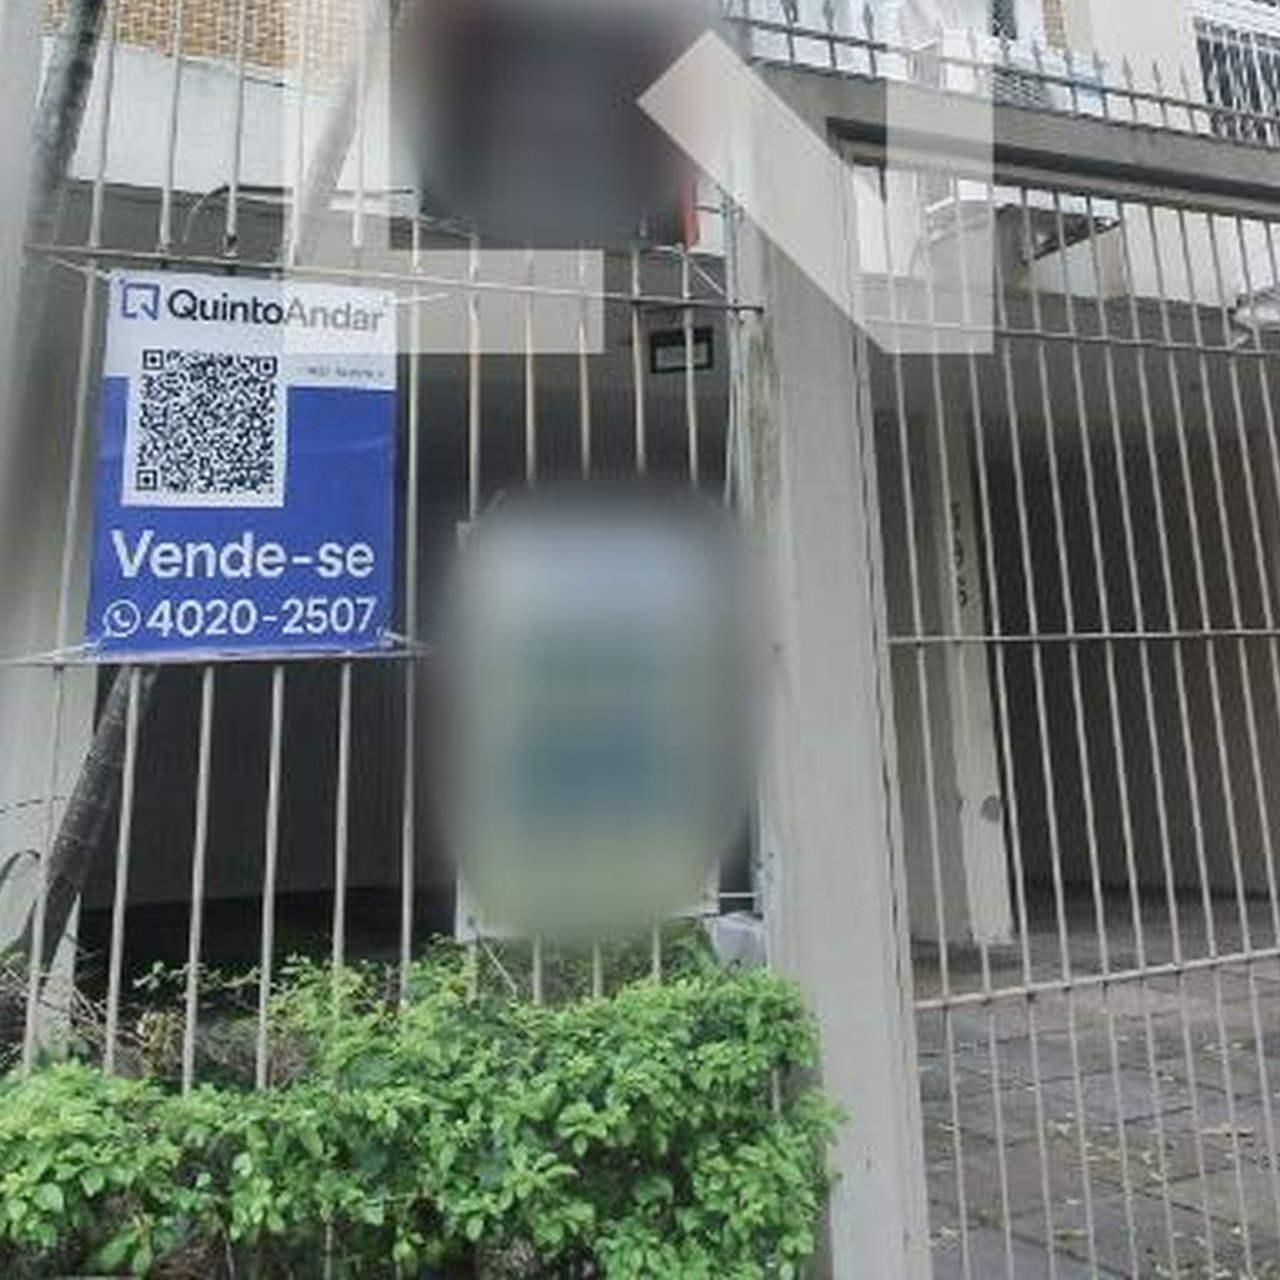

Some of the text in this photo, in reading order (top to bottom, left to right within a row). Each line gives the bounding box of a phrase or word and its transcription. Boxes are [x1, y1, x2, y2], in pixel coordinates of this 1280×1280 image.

[168, 288, 384, 332] QuintoAndar
[110, 530, 375, 578] Vende-se
[146, 596, 378, 638] 4020-2507
